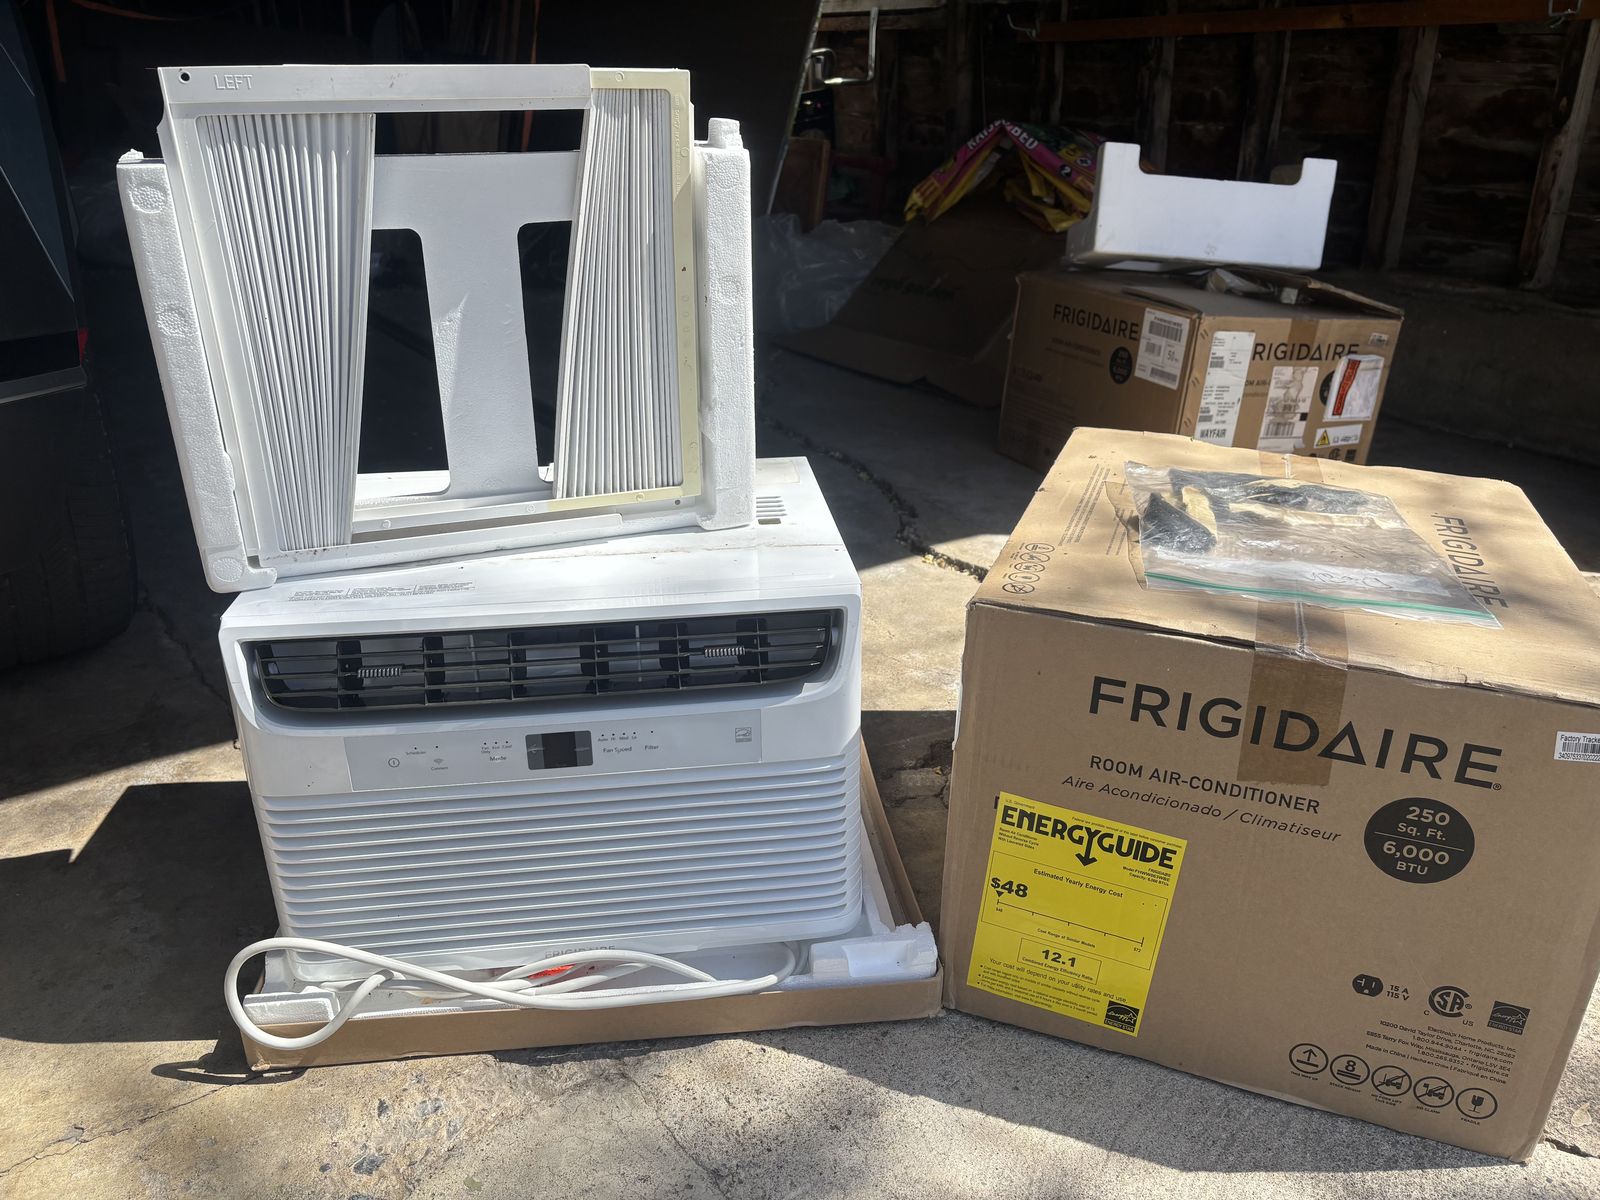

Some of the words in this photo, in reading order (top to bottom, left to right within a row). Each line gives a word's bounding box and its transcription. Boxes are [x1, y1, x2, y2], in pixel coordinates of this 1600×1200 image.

[213, 74, 253, 91] LEFT
[1053, 304, 1139, 341] FRIGIDAIRE
[1200, 428, 1227, 438] WAYFAIR
[1431, 514, 1509, 608] FRIGIDAIRE
[1089, 676, 1503, 789] FRIGIDAIRE
[1560, 734, 1581, 743] Factory
[1090, 755, 1143, 778] ROOM
[1149, 767, 1320, 814] AIR-CONDITIONER
[1062, 775, 1095, 791] Aire
[1098, 783, 1222, 818] Acondicionado
[1239, 812, 1342, 843] Climatiseur
[1405, 806, 1450, 826] 250
[1001, 805, 1177, 869] ENERGYGUIDE
[1397, 823, 1421, 837] Sq.
[1426, 828, 1446, 841] Ft.
[1383, 841, 1450, 865] 6,000
[1396, 861, 1428, 875] BTU
[990, 877, 1028, 898] $48
[1033, 868, 1064, 882] Estimated
[1065, 876, 1084, 889] Yearly
[1085, 881, 1107, 894] Energy
[1108, 887, 1124, 898] Cost
[1042, 949, 1076, 967] 12.1
[1044, 962, 1059, 971] Energy
[989, 958, 1002, 967] Your
[1003, 962, 1015, 970] cost
[1026, 969, 1047, 980] depend
[1057, 978, 1070, 986] your
[1071, 981, 1086, 991] utility
[1087, 987, 1101, 995] rates
[1115, 996, 1128, 1004] use.
[1389, 984, 1399, 992] 15
[1386, 990, 1399, 999] 115
[1462, 1019, 1474, 1027] US
[1488, 1021, 1509, 1031] ENERGY
[1508, 1026, 1522, 1034] STAR
[1380, 1020, 1398, 1029] 10200
[1399, 1025, 1416, 1033] David
[1417, 1030, 1435, 1038] Taylor
[1436, 1035, 1453, 1044] Drive,
[1454, 1039, 1483, 1050] Charlotte,
[1428, 1026, 1456, 1037] Electrolux
[1458, 1034, 1476, 1042] Home
[1477, 1038, 1505, 1050] Products,
[1366, 1044, 1382, 1052] Made
[1389, 1050, 1406, 1058] China
[1382, 1034, 1397, 1043] Terry
[1410, 1042, 1424, 1050] Way,
[1462, 1055, 1484, 1065] Ontario
[1468, 1050, 1513, 1065] frigidaire.com
[1344, 1059, 1356, 1072] 8
[1471, 1063, 1509, 1077] frigidaire.ca
